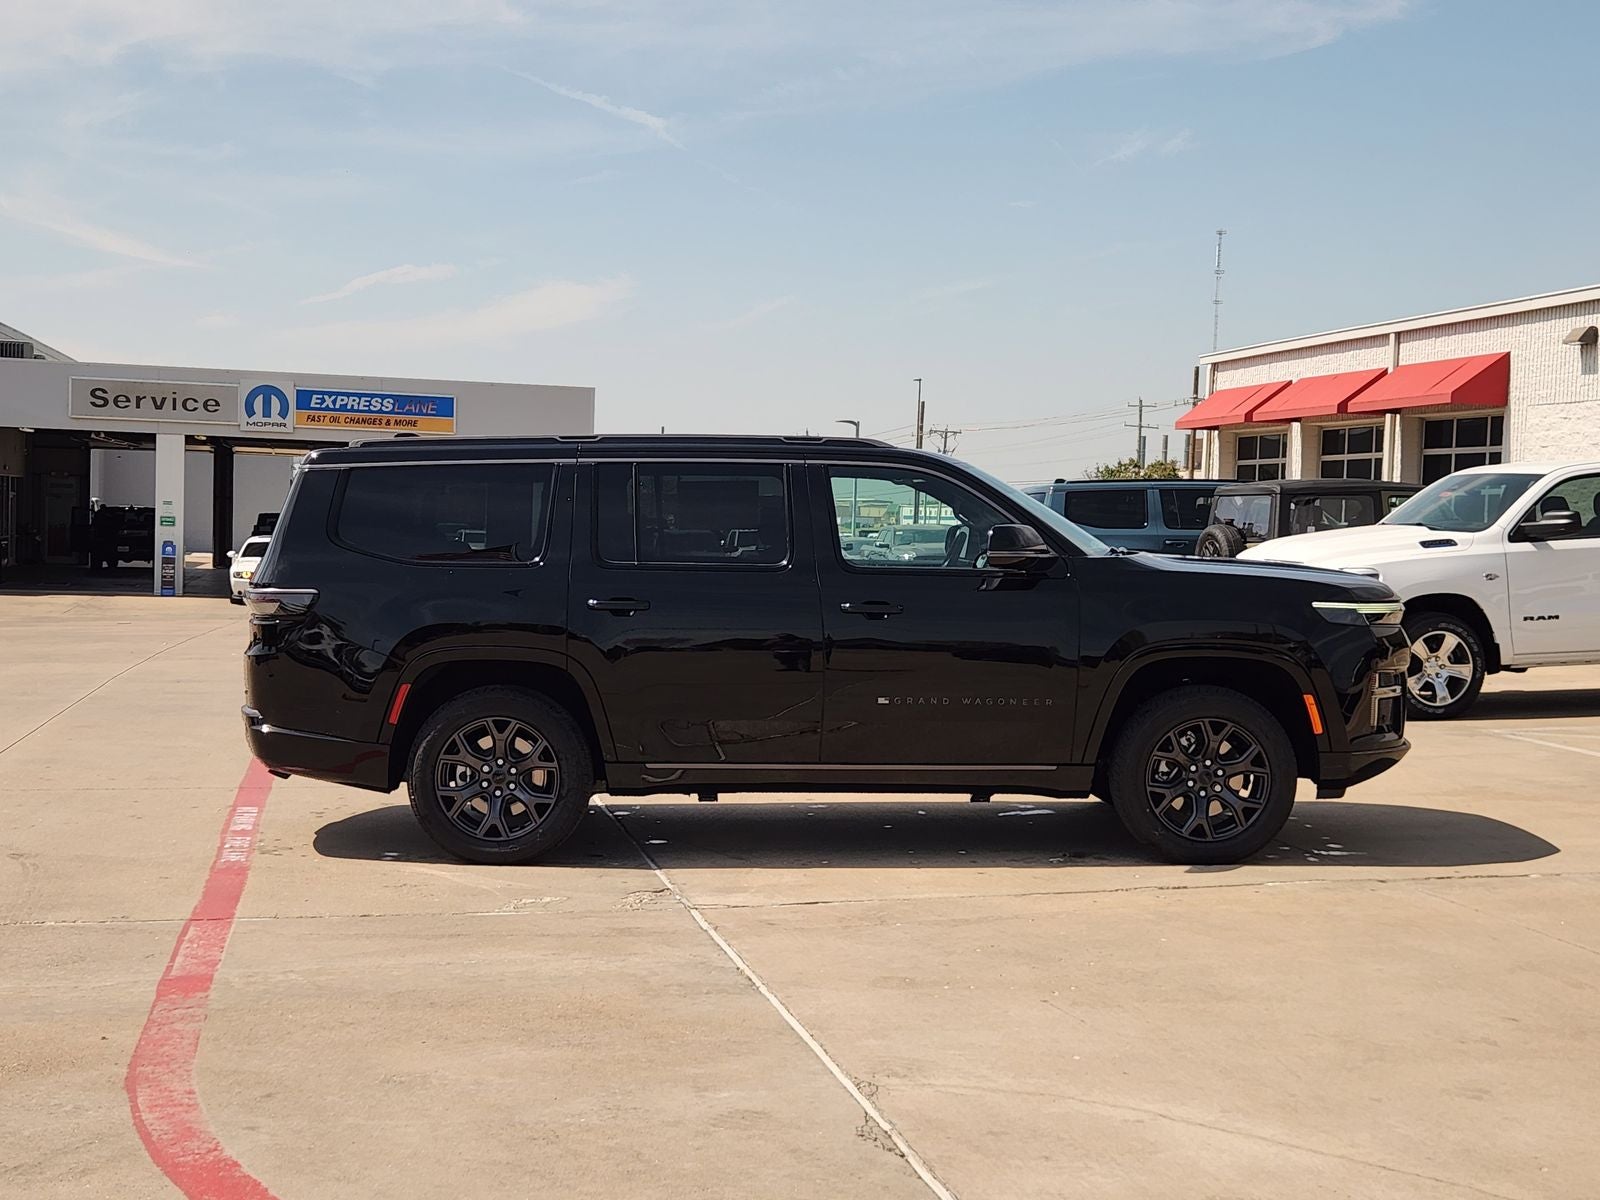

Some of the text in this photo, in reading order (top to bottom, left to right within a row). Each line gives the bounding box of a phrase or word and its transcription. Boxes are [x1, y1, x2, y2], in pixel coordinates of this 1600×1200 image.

[89, 387, 221, 413] Service
[246, 421, 288, 429] MOPAR
[306, 414, 419, 427] FAST OIL CHANGES & MORE
[894, 697, 1053, 706] GRAND WAGONEER
